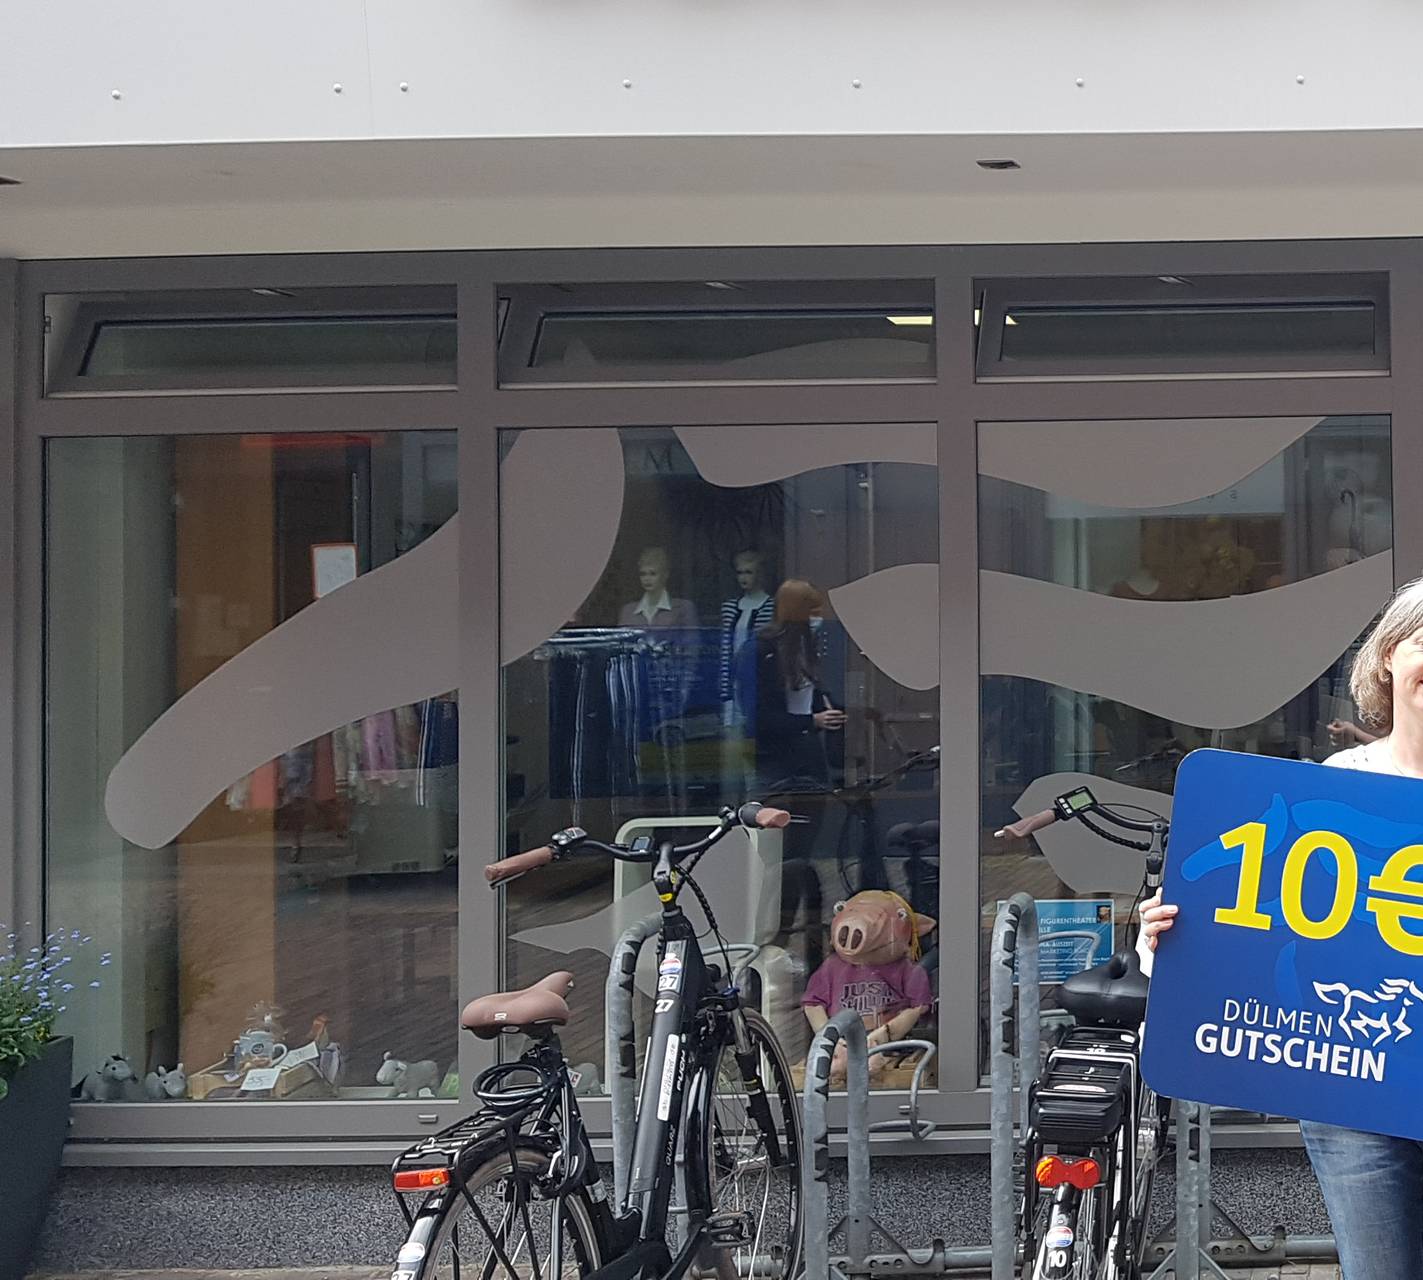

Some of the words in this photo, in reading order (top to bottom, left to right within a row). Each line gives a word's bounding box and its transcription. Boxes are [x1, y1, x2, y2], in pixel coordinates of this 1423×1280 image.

[660, 976, 677, 989] 27
[655, 1000, 674, 1013] 27
[1223, 998, 1333, 1037] DÜLMEN
[1195, 1023, 1386, 1082] GUTSCHEIN
[677, 1050, 686, 1091] PUCH
[1049, 1251, 1067, 1267] 10
